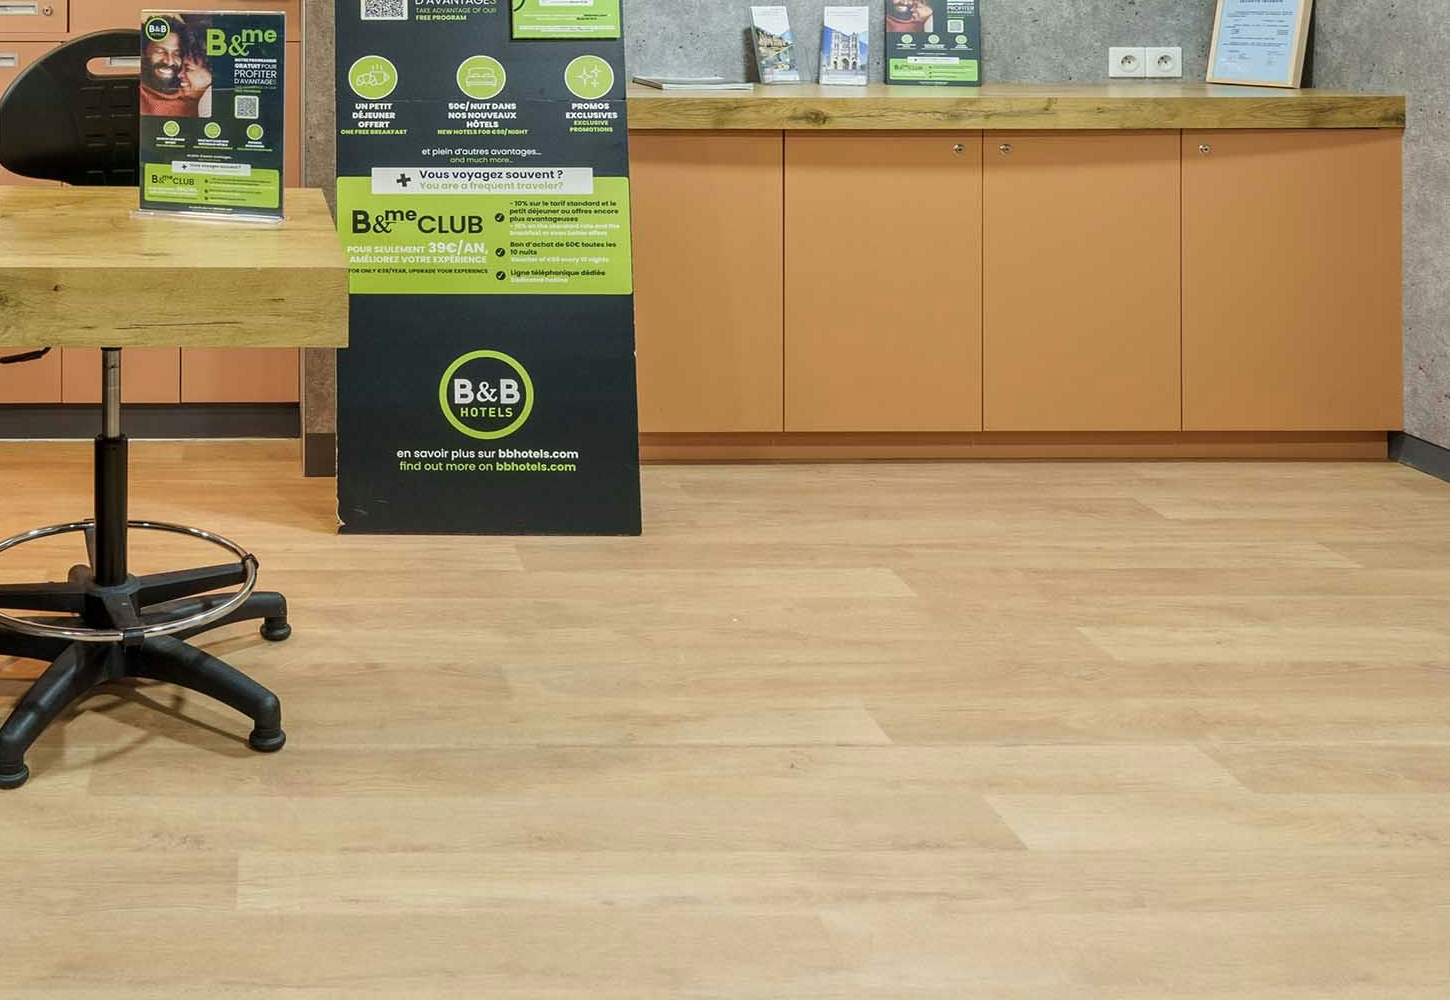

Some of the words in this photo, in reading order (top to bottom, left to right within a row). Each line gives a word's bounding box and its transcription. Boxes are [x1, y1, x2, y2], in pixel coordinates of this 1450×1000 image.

[206, 29, 277, 56] B&me
[234, 69, 277, 78] PROFITER
[352, 110, 396, 119] DÉJEUNER
[466, 119, 499, 128] HÔTELS
[432, 148, 453, 157] plein
[419, 170, 449, 179] Vous
[452, 171, 503, 181] voyagez
[505, 170, 554, 179] souvent
[557, 170, 563, 178] ?
[172, 177, 194, 185] CLUB
[470, 182, 515, 191] frequent
[350, 254, 399, 263] AMÉLIOREZ
[432, 254, 487, 263] EXPÉRIENCE
[531, 269, 579, 277] téléphonique
[454, 378, 520, 404] B&B
[460, 407, 513, 417] HOTELS
[396, 450, 411, 458] en
[413, 449, 449, 458] savoir
[451, 449, 475, 461] plus
[478, 450, 495, 458] sur
[498, 449, 579, 459] bbhotels.com
[400, 461, 421, 471] find
[423, 462, 443, 471] out
[446, 463, 476, 471] more
[478, 463, 493, 471] on
[496, 461, 576, 472] bbhotels.com
